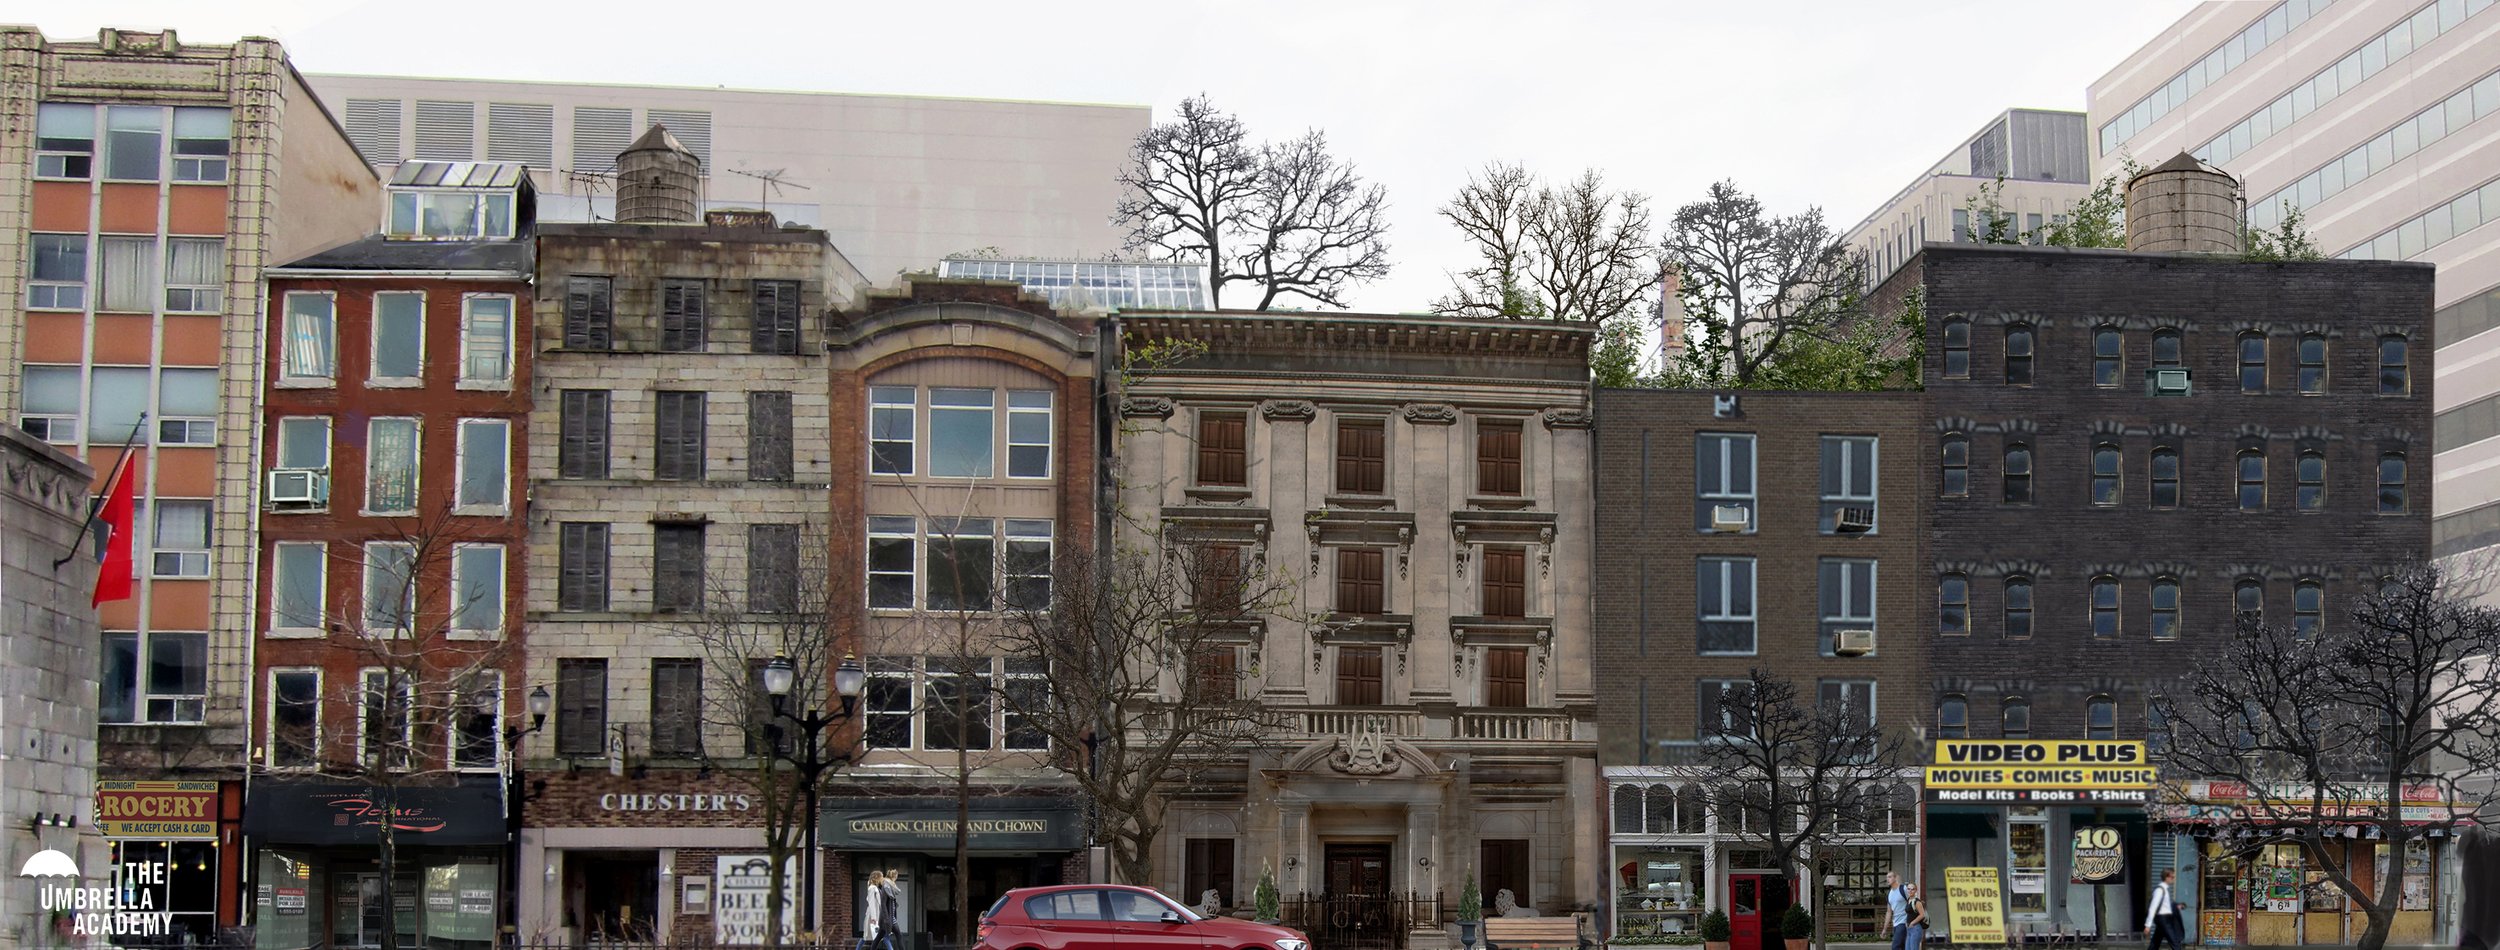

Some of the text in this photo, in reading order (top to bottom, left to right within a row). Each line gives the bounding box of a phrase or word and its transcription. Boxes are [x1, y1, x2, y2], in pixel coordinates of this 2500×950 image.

[1947, 744, 2137, 762] VIDEO PLUS
[1932, 770, 2152, 783] MOVIES COMICS MUSIC
[177, 782, 215, 790] SANDWICHES
[1938, 790, 2146, 801] Model Kits Books T-Shirts
[102, 795, 209, 817] ROCERY
[600, 793, 750, 811] CHESTER'S
[122, 823, 132, 832] WE
[134, 823, 161, 833] ACCEPT
[163, 823, 181, 833] CASH
[183, 824, 189, 832] &
[191, 824, 211, 833] CARD
[852, 820, 911, 832] CAMERON,
[995, 820, 1043, 831] CHOWN
[2076, 828, 2119, 849] 10
[2076, 849, 2093, 857] PACK
[2072, 854, 2123, 880] Special
[727, 878, 771, 886] CHESTE
[1950, 887, 1998, 897] CDs DVDs
[721, 893, 792, 909] BEES
[1957, 902, 1993, 912] MOVIES
[1961, 916, 1992, 926] BOOKS
[722, 924, 791, 937] WORD
